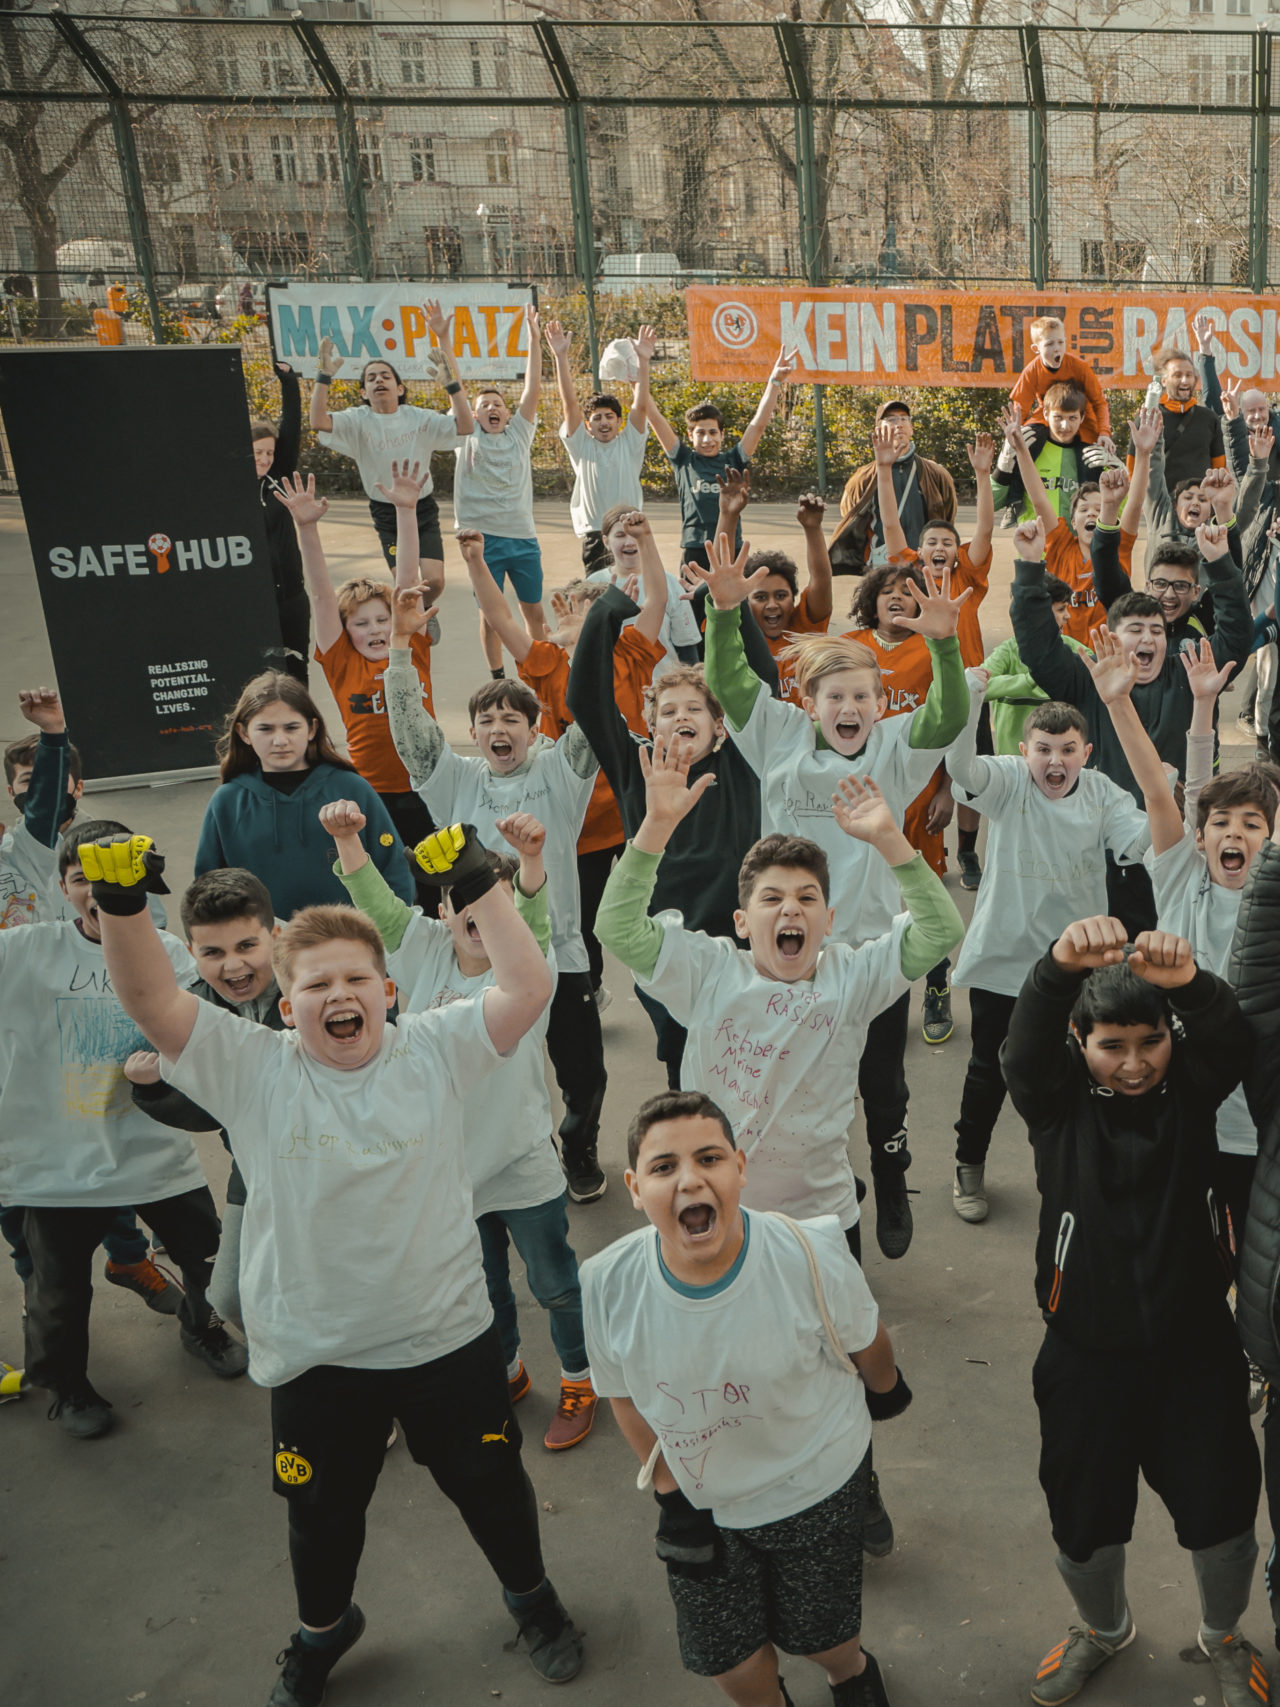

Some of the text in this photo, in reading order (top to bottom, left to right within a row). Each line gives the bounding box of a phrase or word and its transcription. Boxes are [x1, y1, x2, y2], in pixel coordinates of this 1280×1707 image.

[779, 301, 898, 373] KEIN
[691, 479, 728, 494] Jee
[49, 535, 254, 579] SAFE HUB
[148, 659, 209, 675] REALISING
[150, 674, 216, 689] POTENTIAL.
[152, 687, 209, 702] CHANGING
[155, 702, 196, 715] LIVES.
[656, 1381, 750, 1427] STOP
[280, 1455, 308, 1477] BVB
[287, 1474, 299, 1483] 09
